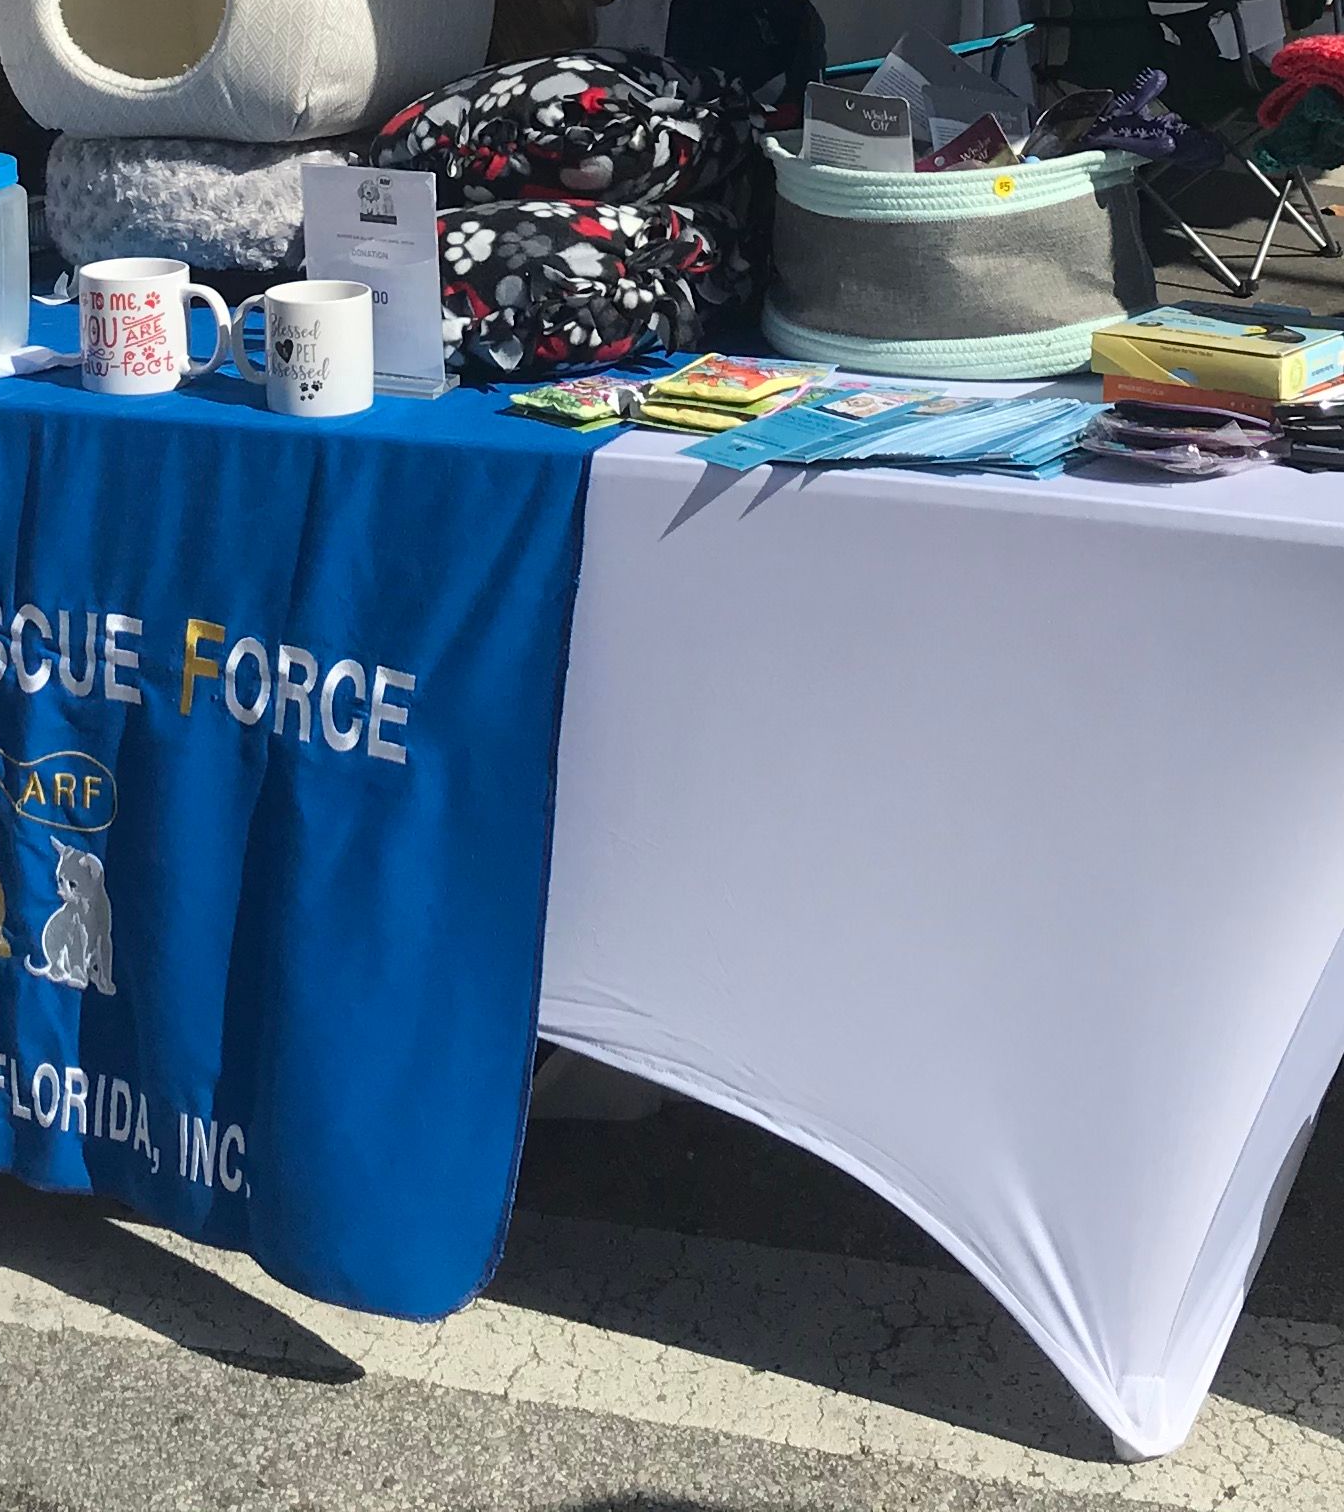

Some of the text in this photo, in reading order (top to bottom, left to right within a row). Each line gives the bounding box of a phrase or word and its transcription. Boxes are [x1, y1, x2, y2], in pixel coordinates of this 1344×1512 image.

[999, 181, 1011, 193] $5
[351, 249, 389, 260] DONATION
[89, 291, 142, 312] TO ME,
[124, 319, 163, 345] ARE
[270, 312, 321, 341] Blessed
[85, 351, 174, 378] aw-fect
[296, 342, 317, 363] PET
[268, 356, 330, 381] bsessed
[179, 618, 419, 766] FORCE
[22, 773, 103, 813] ARF
